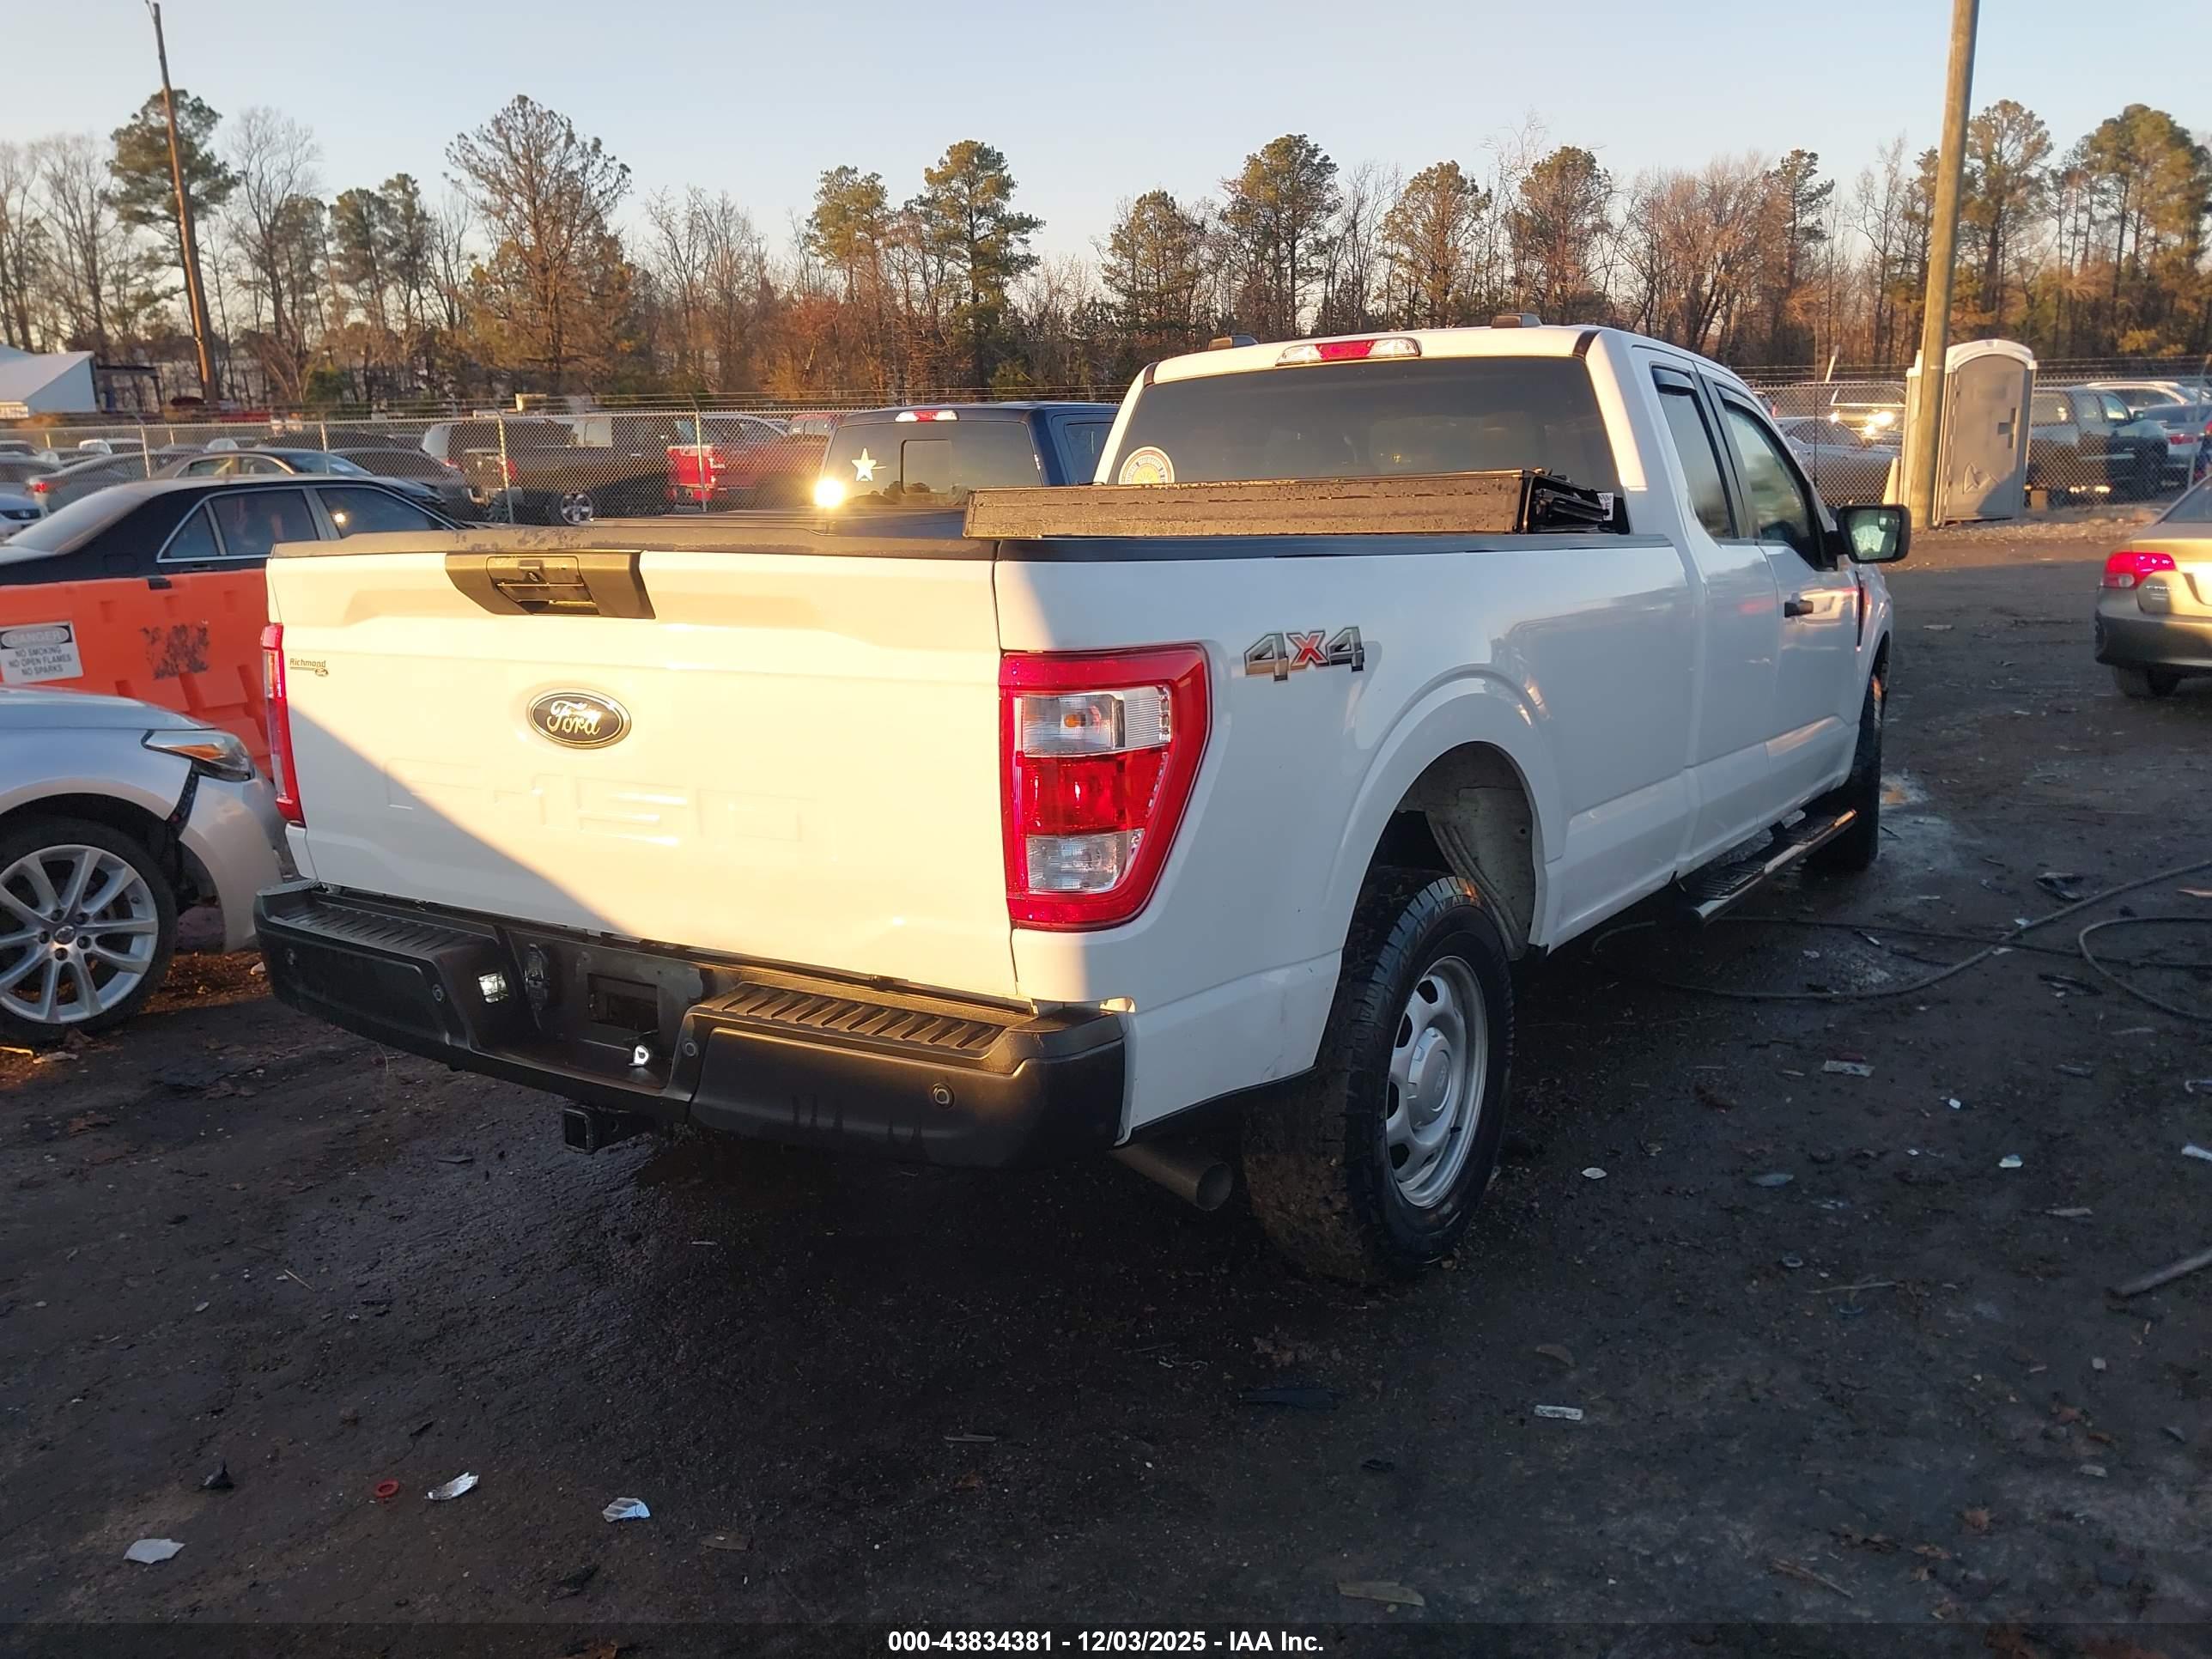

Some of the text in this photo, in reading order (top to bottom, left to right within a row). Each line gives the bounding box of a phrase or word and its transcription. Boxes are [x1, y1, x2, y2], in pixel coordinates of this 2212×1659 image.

[9, 630, 61, 644] DANGER
[15, 645, 63, 658] NO SMOKING
[9, 653, 72, 667] NO OPEN FLAMES
[289, 658, 326, 668] Richmond
[21, 664, 64, 676] NO SPARKS
[546, 700, 602, 735] Ford
